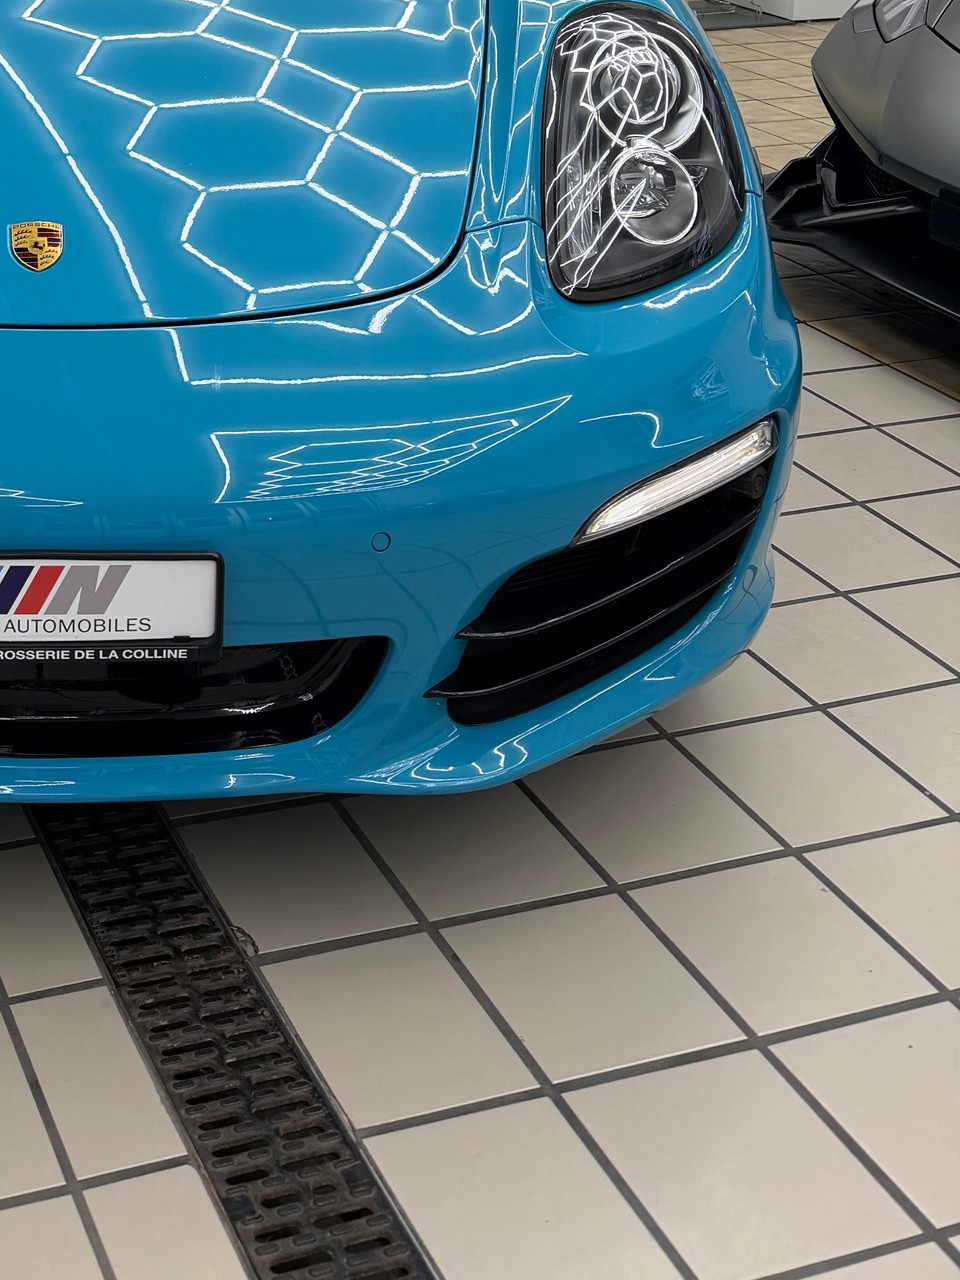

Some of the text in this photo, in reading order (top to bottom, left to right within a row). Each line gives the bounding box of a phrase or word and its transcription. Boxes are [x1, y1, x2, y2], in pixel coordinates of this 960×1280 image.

[3, 617, 152, 634] AUTOMOBILES
[74, 649, 95, 660] DE
[98, 649, 119, 660] LA
[122, 648, 188, 660] COLLINE
